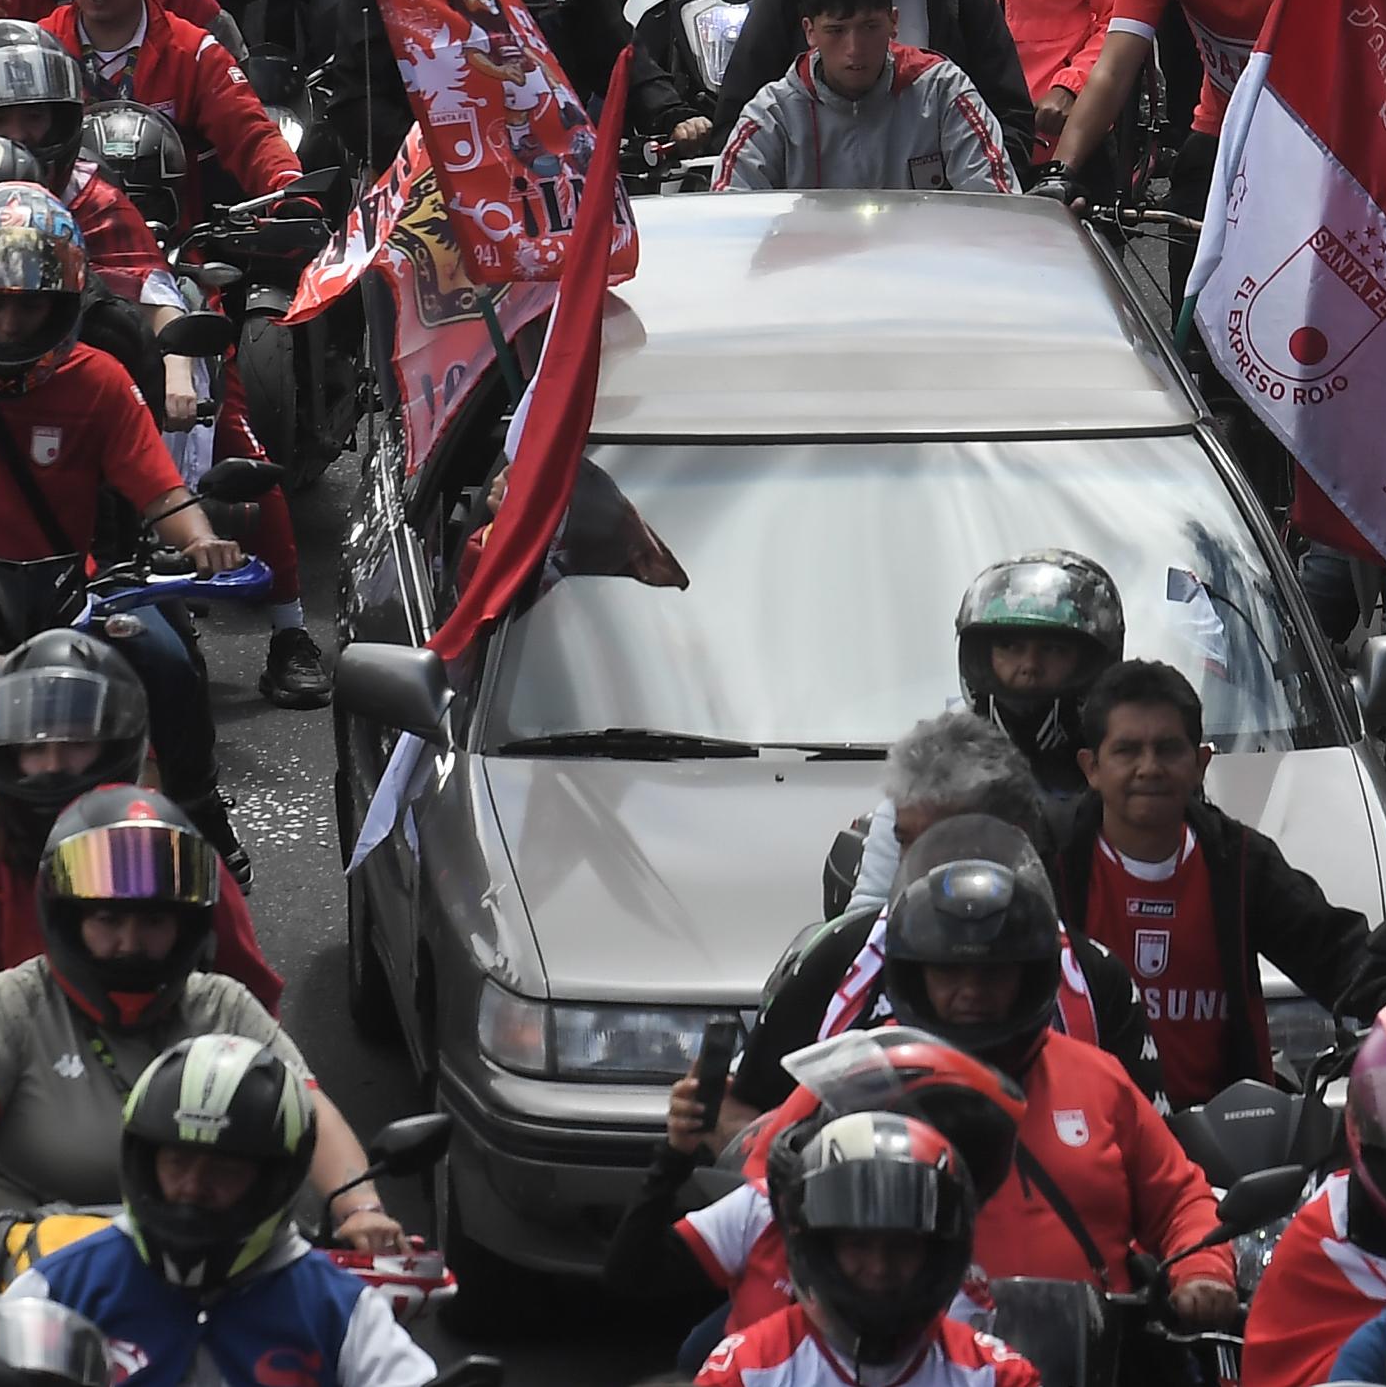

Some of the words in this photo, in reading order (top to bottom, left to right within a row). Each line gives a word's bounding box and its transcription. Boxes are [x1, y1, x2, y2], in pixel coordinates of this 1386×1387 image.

[1313, 232, 1369, 292] SANTA
[1234, 275, 1256, 302] EL
[1227, 308, 1286, 402] EXPRESO
[1292, 374, 1348, 405] ROJO
[1141, 901, 1173, 914] lotto
[1224, 1107, 1276, 1121] HONDA
